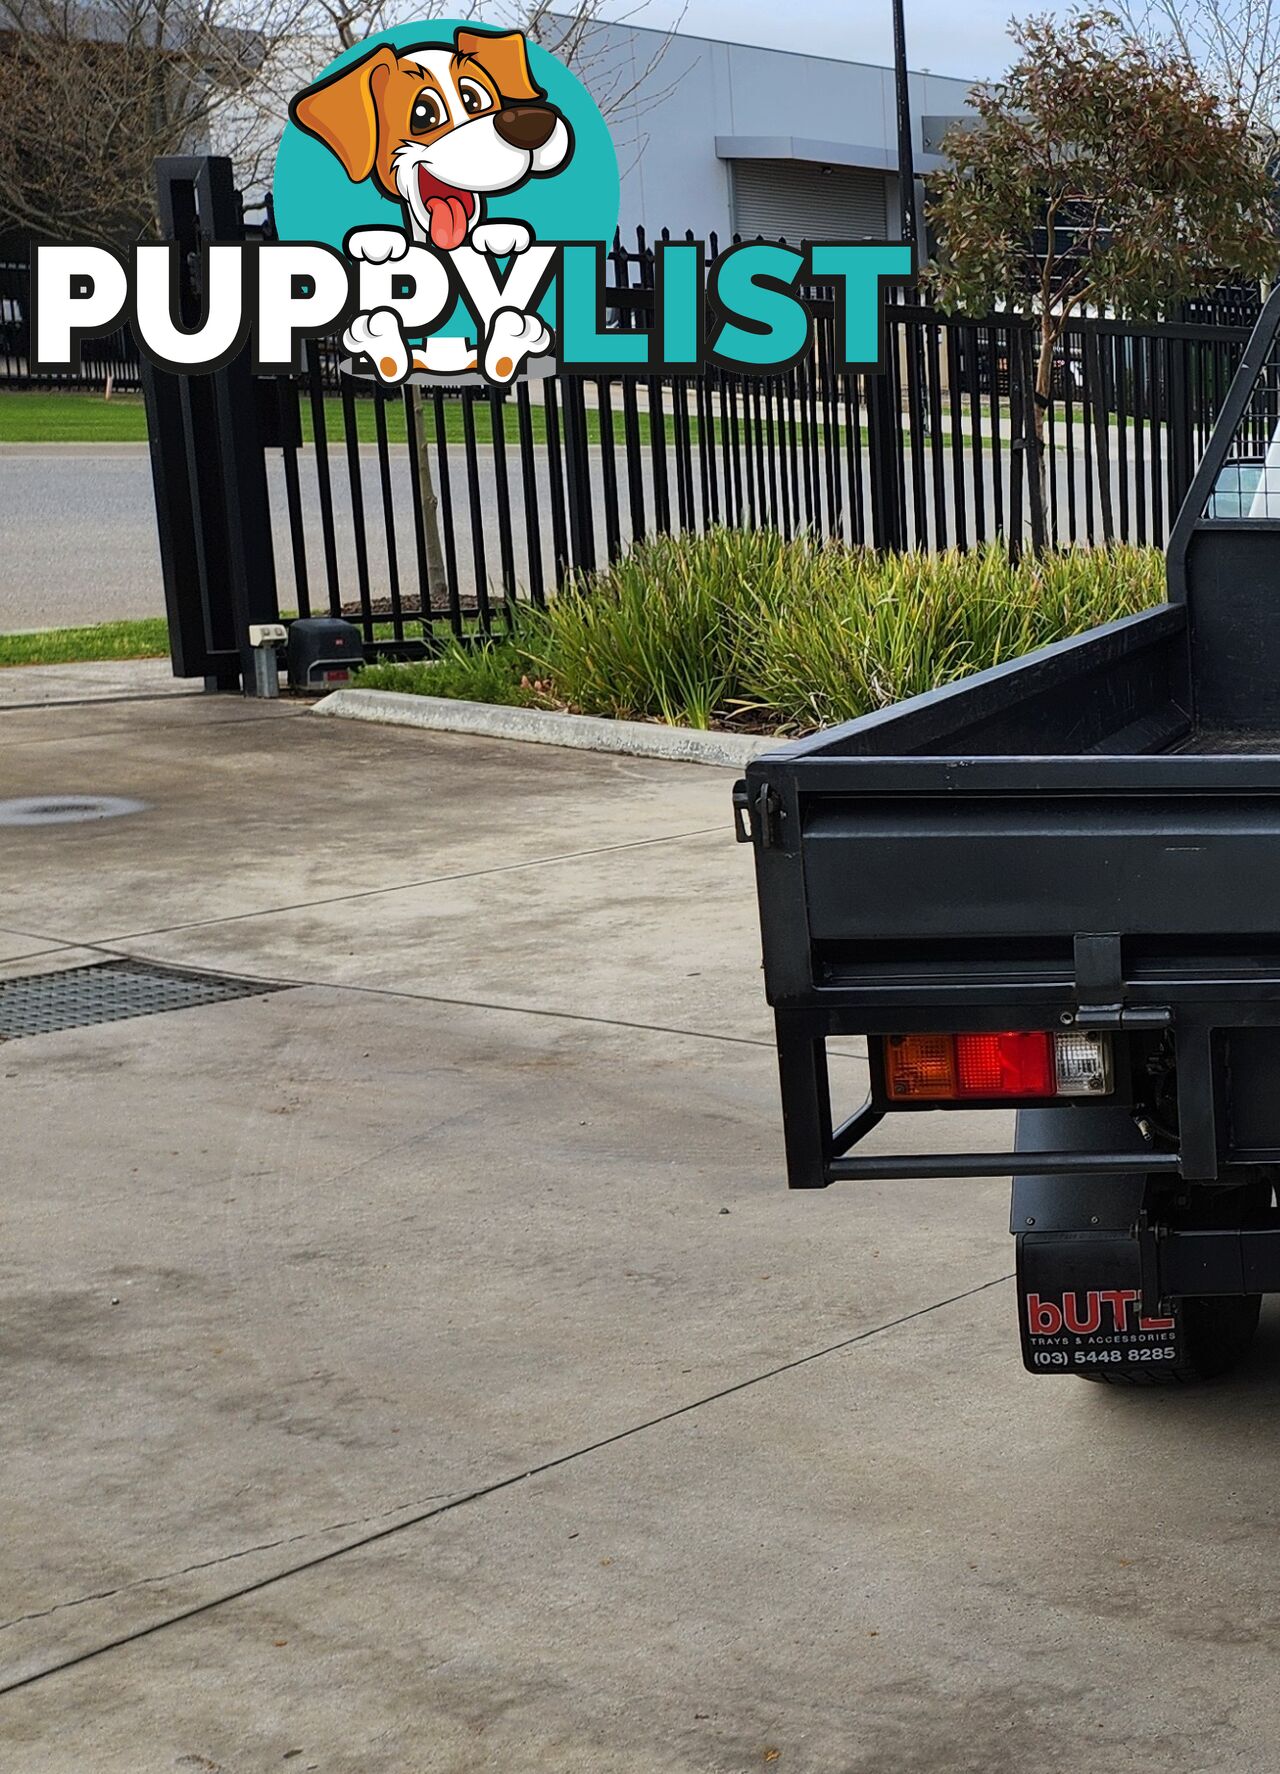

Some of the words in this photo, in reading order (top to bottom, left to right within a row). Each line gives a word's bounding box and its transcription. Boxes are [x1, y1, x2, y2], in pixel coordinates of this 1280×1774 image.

[1030, 1337, 1069, 1346] TRAYS
[1075, 1336, 1082, 1345] &
[1088, 1332, 1176, 1344] ACCESSORIES
[1033, 1351, 1068, 1366] (03)
[1074, 1349, 1122, 1364] 5448
[1127, 1347, 1176, 1362] 8285
